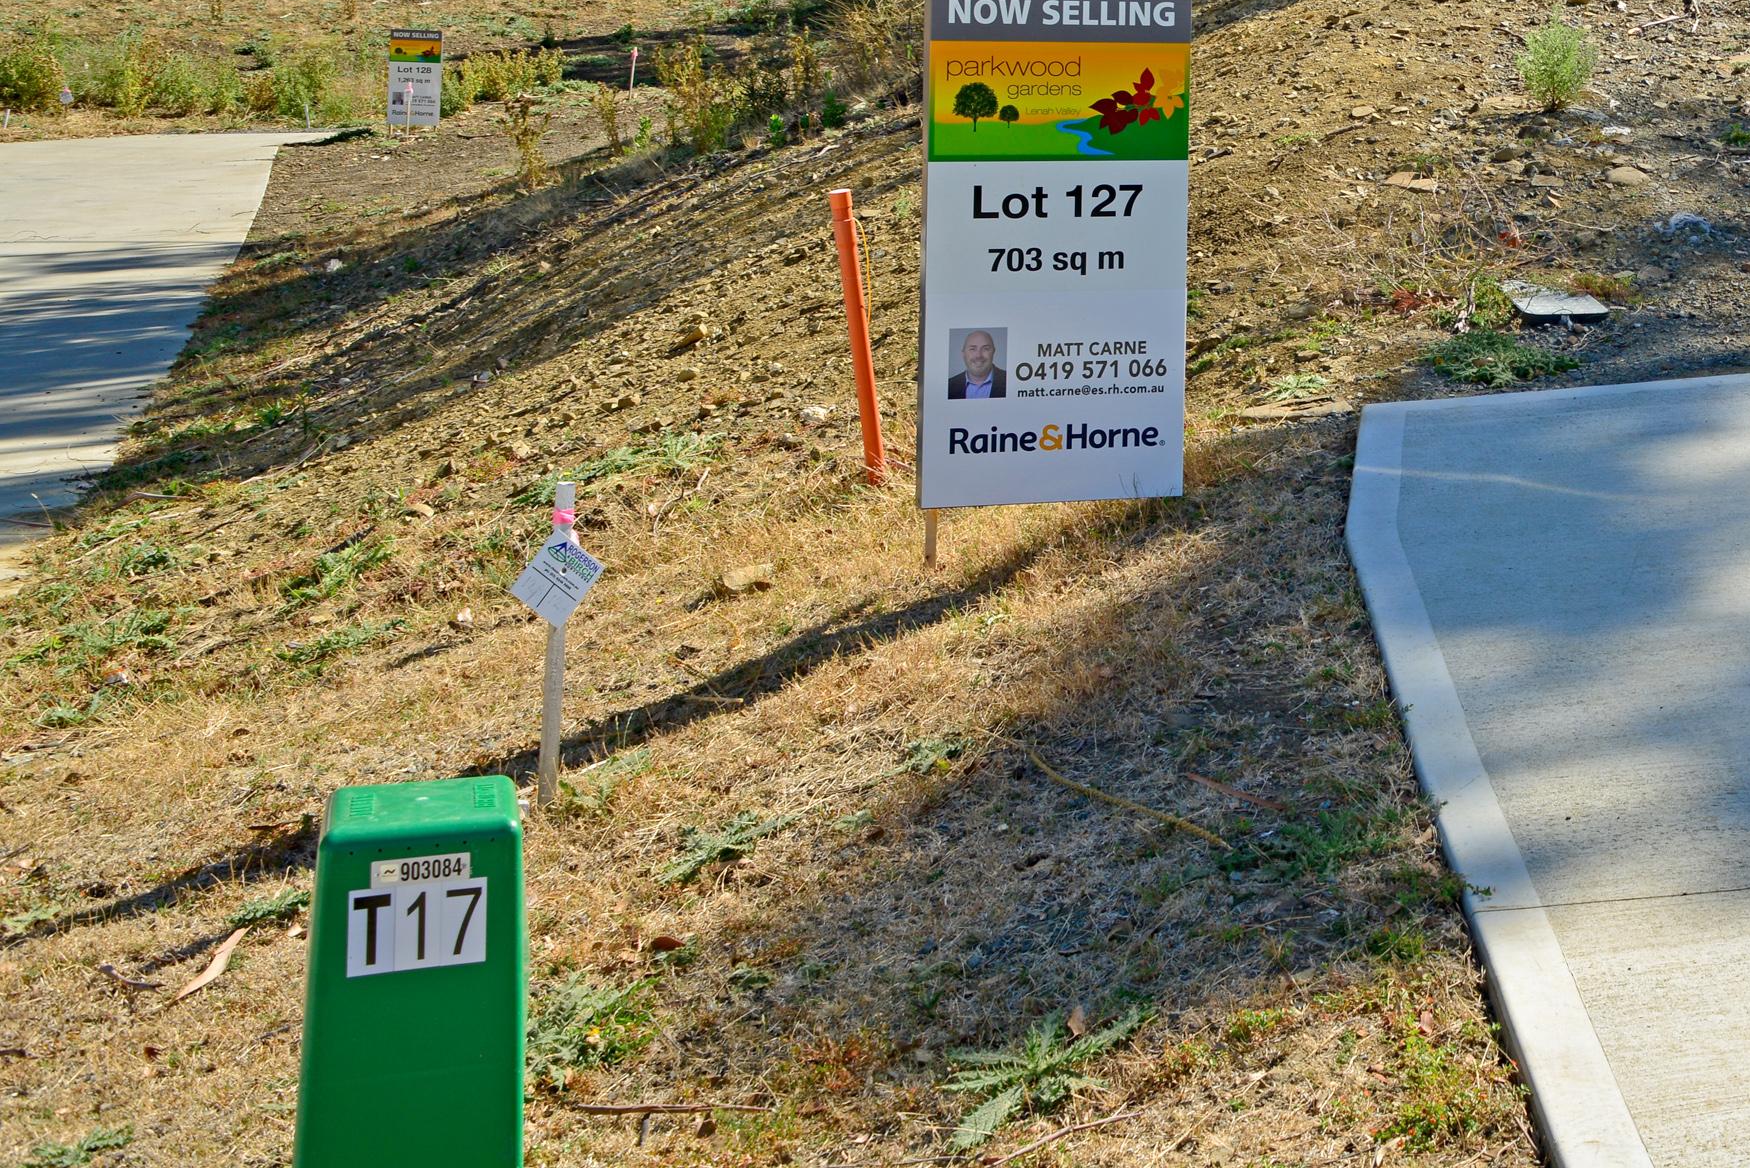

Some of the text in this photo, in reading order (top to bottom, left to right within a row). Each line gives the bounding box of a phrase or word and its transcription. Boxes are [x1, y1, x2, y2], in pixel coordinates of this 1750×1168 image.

[1042, 0, 1176, 27] SELLING
[397, 66, 432, 74] Lot 128
[946, 55, 1081, 81] parkwood
[1007, 81, 1082, 99] gardens
[973, 184, 1143, 219] Lot 127
[988, 247, 1125, 275] 703 sq m
[1037, 340, 1147, 358] MATT CARNE
[1082, 360, 1119, 379] 571
[1128, 358, 1167, 377] 066
[1017, 384, 1165, 398] matt.carne@es.rh.com.au
[567, 544, 600, 574] ROGERSON
[568, 557, 595, 580] BIRCH
[400, 857, 463, 882] 903084
[353, 886, 483, 966] T17
